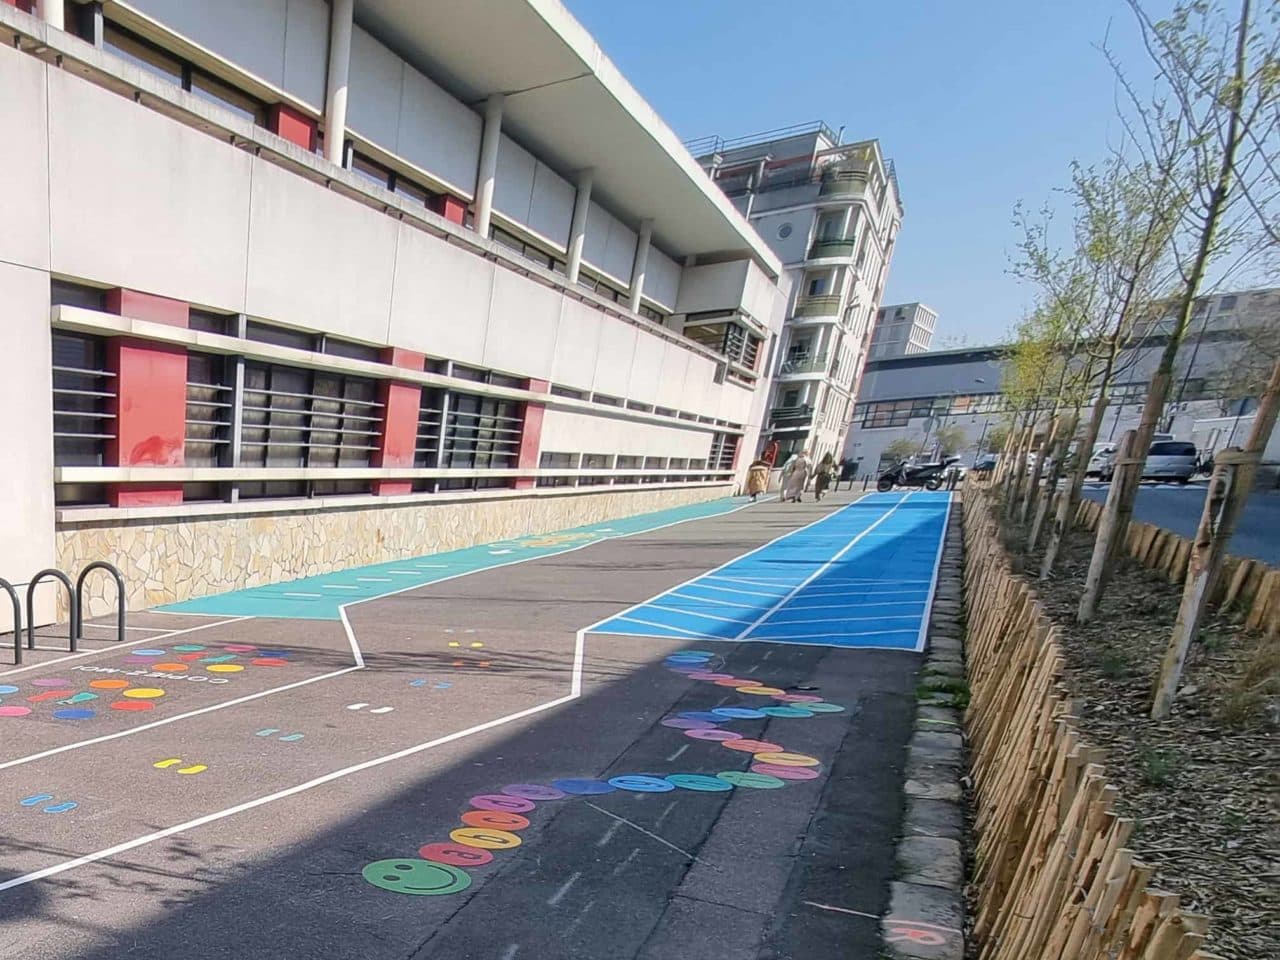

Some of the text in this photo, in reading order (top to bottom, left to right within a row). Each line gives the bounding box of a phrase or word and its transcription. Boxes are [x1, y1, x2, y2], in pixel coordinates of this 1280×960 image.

[482, 816, 519, 825] c
[456, 833, 510, 845] b
[442, 849, 483, 860] a
